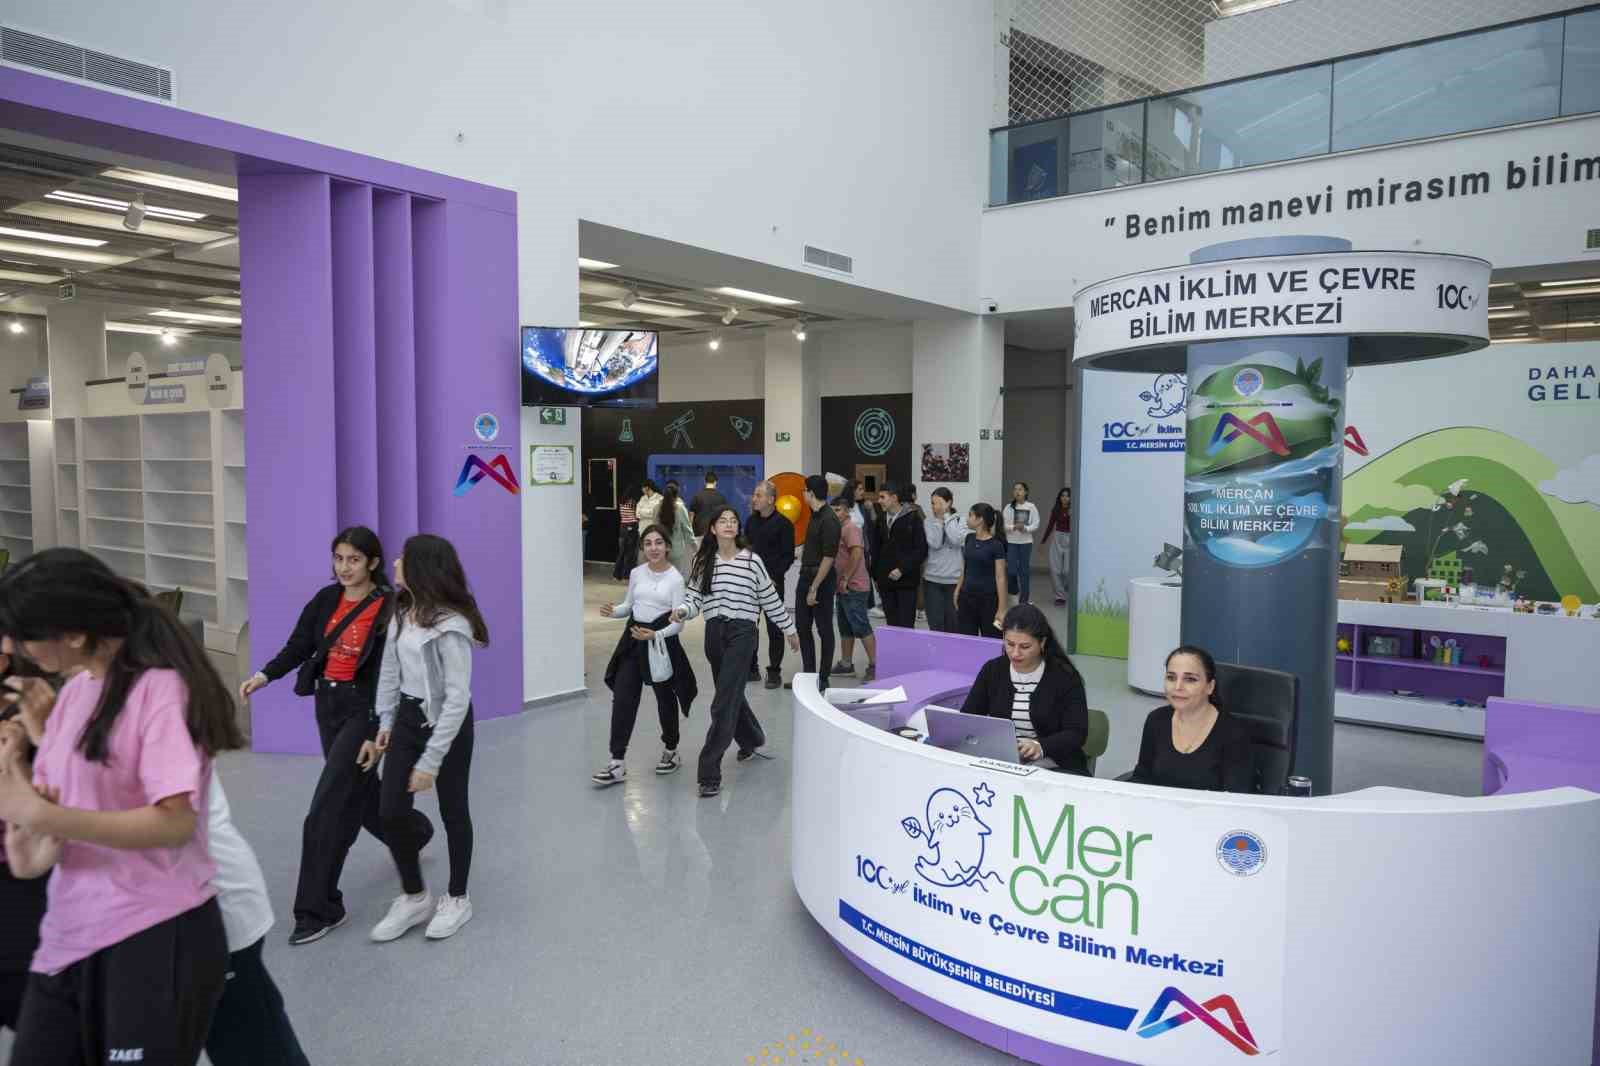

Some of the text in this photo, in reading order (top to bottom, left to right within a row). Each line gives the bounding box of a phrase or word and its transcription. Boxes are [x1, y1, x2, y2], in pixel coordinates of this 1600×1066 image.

[1125, 206, 1210, 239] Benim
[1222, 185, 1334, 226] manevi
[1346, 171, 1490, 210] mirasım
[1506, 152, 1600, 190] bilim
[1090, 267, 1416, 318] MERCAN İKLİM VE ÇEVRE
[1130, 297, 1342, 339] BİLİM MERKEZİ
[1528, 365, 1596, 381] DAHA
[1528, 382, 1600, 402] GEL
[1216, 488, 1274, 500] MERCAN
[1254, 504, 1273, 516] VE
[1276, 504, 1319, 519] ÇEVRE
[1013, 794, 1153, 881] Mer
[1009, 865, 1139, 936] can
[913, 883, 953, 915] İklim
[960, 907, 982, 925] ve
[988, 914, 1050, 945] Çevre
[1058, 931, 1116, 960] Bilim
[1125, 945, 1225, 977] Merkezi
[876, 924, 910, 954] MERSİN
[912, 946, 982, 984] BÜYÜKŞEHİR
[985, 974, 1056, 1008] BELEDİYESİ
